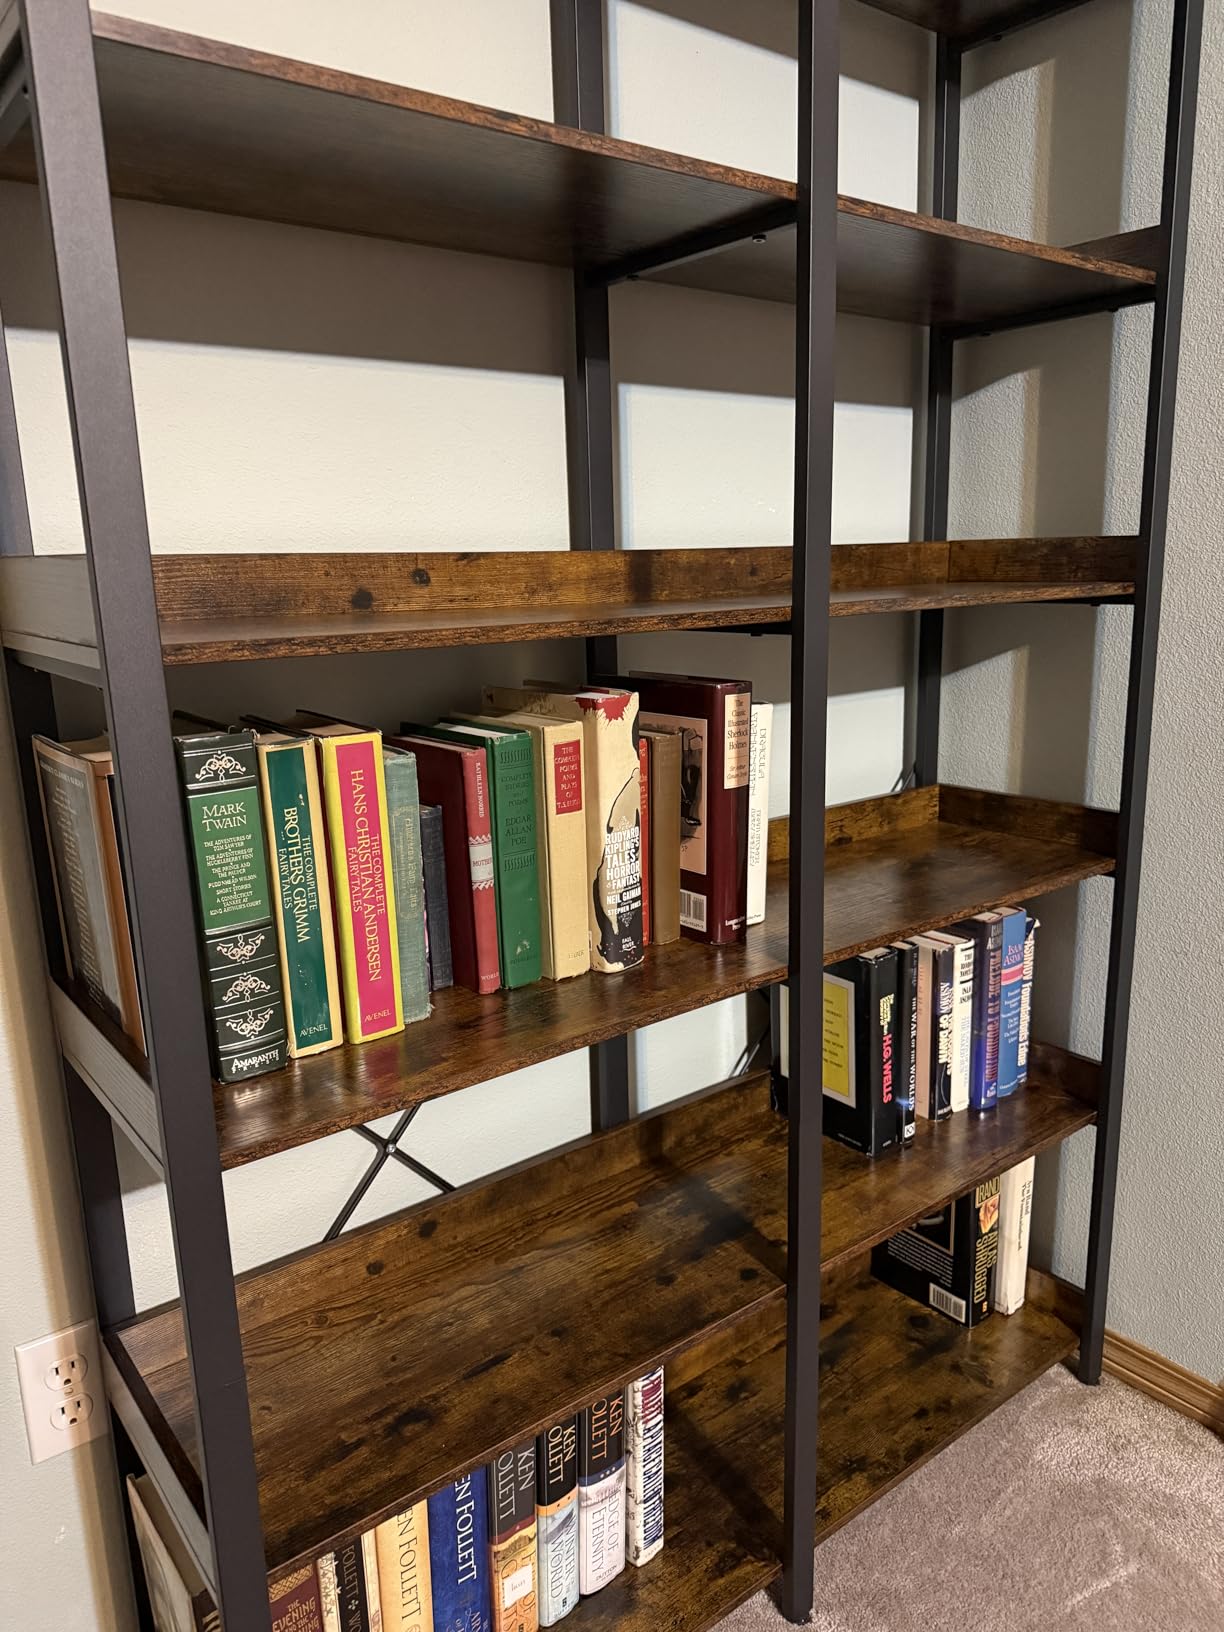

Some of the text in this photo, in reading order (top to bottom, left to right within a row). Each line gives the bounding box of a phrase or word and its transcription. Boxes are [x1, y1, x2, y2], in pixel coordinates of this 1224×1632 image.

[202, 801, 246, 818] MARK
[505, 815, 532, 827] EDGAR
[202, 815, 247, 832] TWAIN
[505, 825, 532, 837] ALLAN
[214, 835, 245, 846] ADVENTURES
[226, 841, 244, 849] SAWYER
[511, 836, 527, 847] POE
[605, 838, 640, 855] KIPLING'S
[606, 826, 640, 845] RUDYARD
[206, 852, 254, 867] HUCKLEBERRY FINN
[216, 849, 246, 859] ADVENTURES
[606, 848, 636, 869] TALES
[222, 864, 240, 873] PRINCE
[239, 874, 257, 883] WILSON
[279, 848, 293, 909] FAIRY TALES
[284, 807, 311, 943] BROTHERS GRIMM
[302, 835, 317, 911] THE COMPLETE
[348, 847, 363, 913] FAIRY TALES
[351, 769, 382, 982] HANS CHRISTIAN ANDERSEN
[370, 834, 385, 915] THE COMPLETE
[606, 861, 640, 881] HORROR
[216, 884, 251, 895] SHORT STORIES
[612, 872, 640, 890] FANTASY
[221, 891, 253, 902] CONNECTICUT
[246, 900, 261, 908] COURT
[606, 894, 622, 905] NEIL
[622, 886, 641, 902] GAIMAN
[607, 904, 630, 916] STEPHEN
[1022, 938, 1035, 980] ASIMOV
[364, 1009, 392, 1023] AVENEL
[299, 1024, 328, 1037] AVENEL
[938, 1014, 950, 1064] OF DAWN
[232, 1049, 279, 1068] AMARANTH
[883, 1061, 892, 1104] WELLS
[908, 1064, 916, 1112] WORLDS
[978, 1176, 1000, 1200] RAND
[986, 1231, 998, 1269] ATLAS
[974, 1236, 987, 1304] SHRUGGED
[610, 1395, 623, 1437] KEN
[592, 1398, 607, 1461] OLLETT
[548, 1425, 564, 1485] OLLETT
[563, 1425, 576, 1463] KEN
[517, 1446, 535, 1491] KEN
[497, 1450, 516, 1521] OLLETT
[454, 1474, 477, 1585] EN FOLLETT
[607, 1489, 620, 1552] EDGE OF
[565, 1515, 576, 1582] WINTER
[592, 1506, 607, 1573] ETERNITY
[342, 1544, 360, 1599] FOLLETT
[396, 1507, 422, 1621] EN FOLLETT
[551, 1532, 565, 1599] WORLD
[596, 1564, 617, 1581] DUTTON
[287, 1599, 301, 1612] THE
[523, 1591, 536, 1613] OF
[272, 1596, 316, 1632] EVENING
